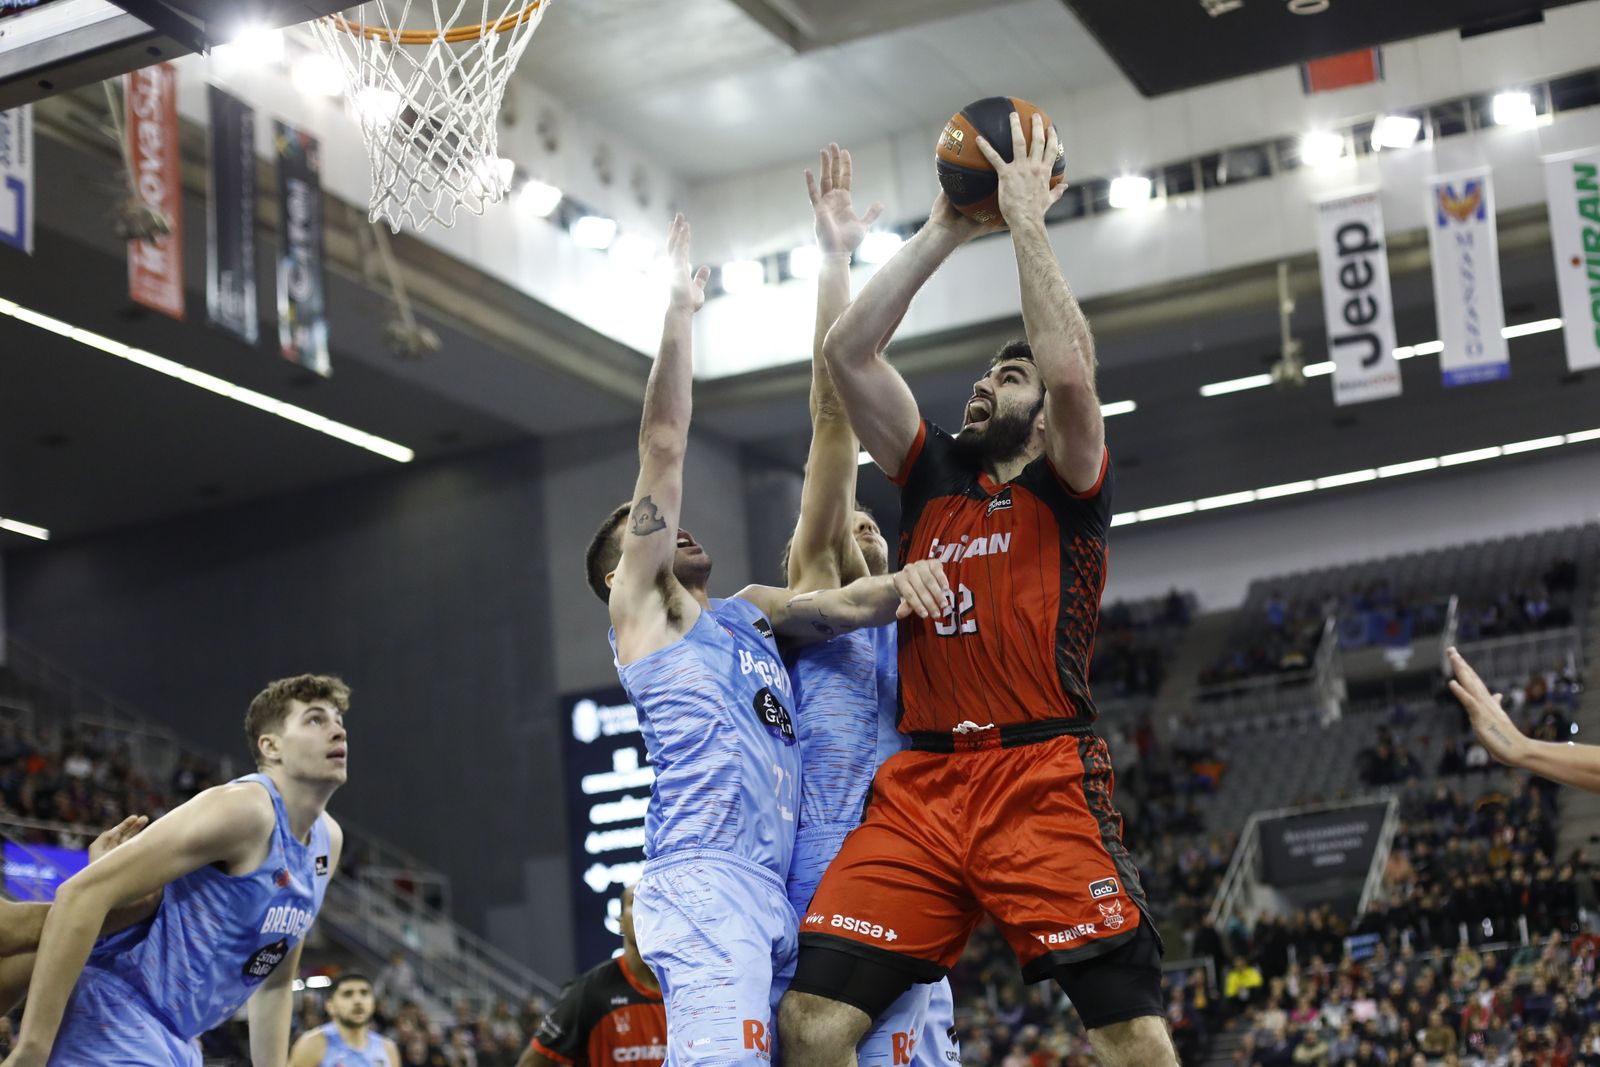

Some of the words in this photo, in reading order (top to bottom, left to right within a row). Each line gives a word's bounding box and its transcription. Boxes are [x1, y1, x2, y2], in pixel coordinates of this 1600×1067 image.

[1334, 220, 1383, 369] Jeep
[934, 582, 978, 636] 32
[1094, 884, 1113, 896] acb
[1048, 923, 1097, 944] BERNER
